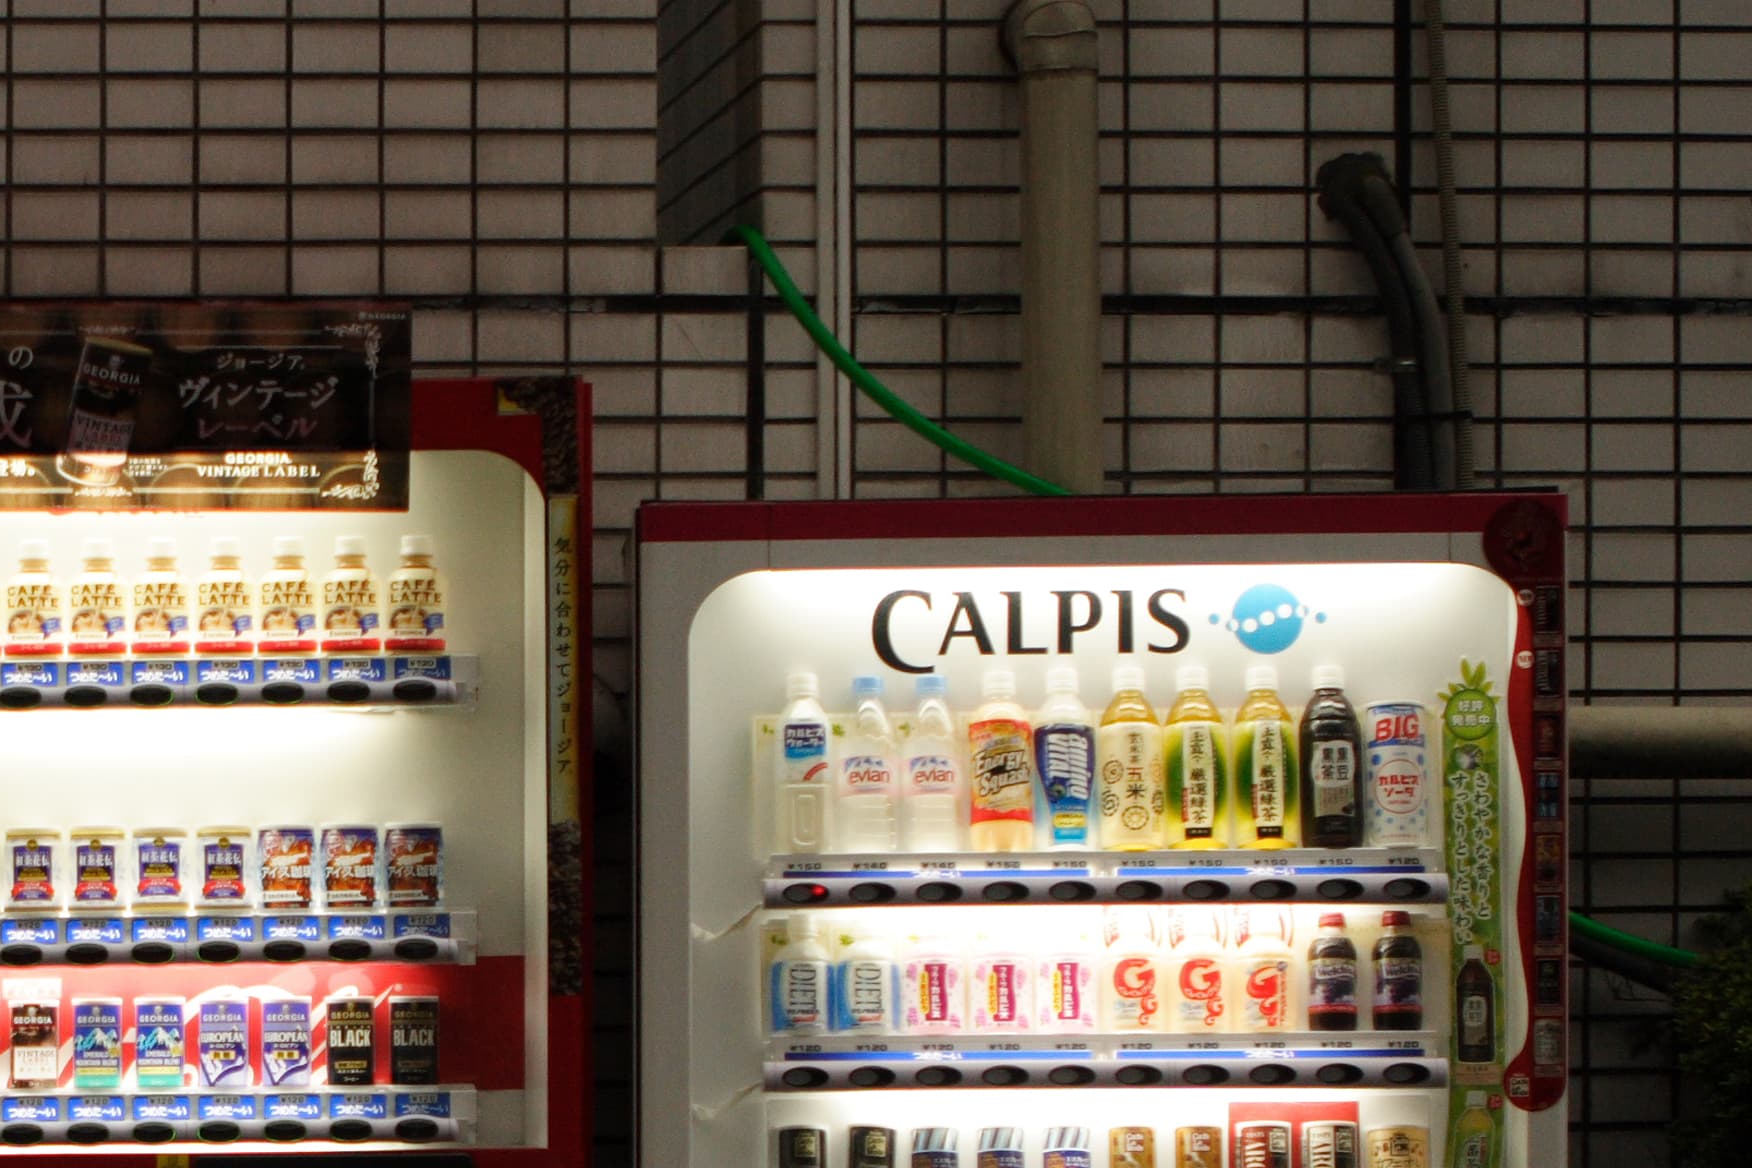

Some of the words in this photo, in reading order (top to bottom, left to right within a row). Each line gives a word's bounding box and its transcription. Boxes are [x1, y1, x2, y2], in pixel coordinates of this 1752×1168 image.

[82, 362, 142, 386] GEORGIA
[177, 375, 340, 411] ヴィンテージ
[197, 465, 260, 478] VINTAGE
[263, 465, 321, 478] LABEL
[7, 597, 59, 609] LATTE
[71, 596, 122, 608] LATTE
[134, 593, 186, 605] LATTE
[199, 593, 250, 605] LATTE
[262, 592, 313, 605] LATTE
[324, 592, 376, 604] LATTE
[390, 591, 442, 603] LATTE
[871, 588, 1191, 674] CALPIS
[1375, 714, 1420, 742] BIG
[974, 749, 1024, 772] Energy
[849, 769, 890, 784] evian
[915, 771, 955, 784] evian
[979, 769, 1031, 797] Squash
[1378, 774, 1419, 786] カルピス
[1384, 786, 1415, 797] ソーダ
[1473, 772, 1491, 921] さわやかな香りと
[1449, 772, 1473, 945] すっきりとした味わい
[14, 1016, 52, 1025] GEORGIA
[77, 1016, 116, 1024] GEORGIA
[139, 1014, 179, 1023] GEORGIA
[202, 1014, 242, 1022] GEORGIA
[266, 1014, 306, 1022] GEORGIA
[329, 1029, 371, 1048] BLACK
[393, 1028, 435, 1046] BLACK
